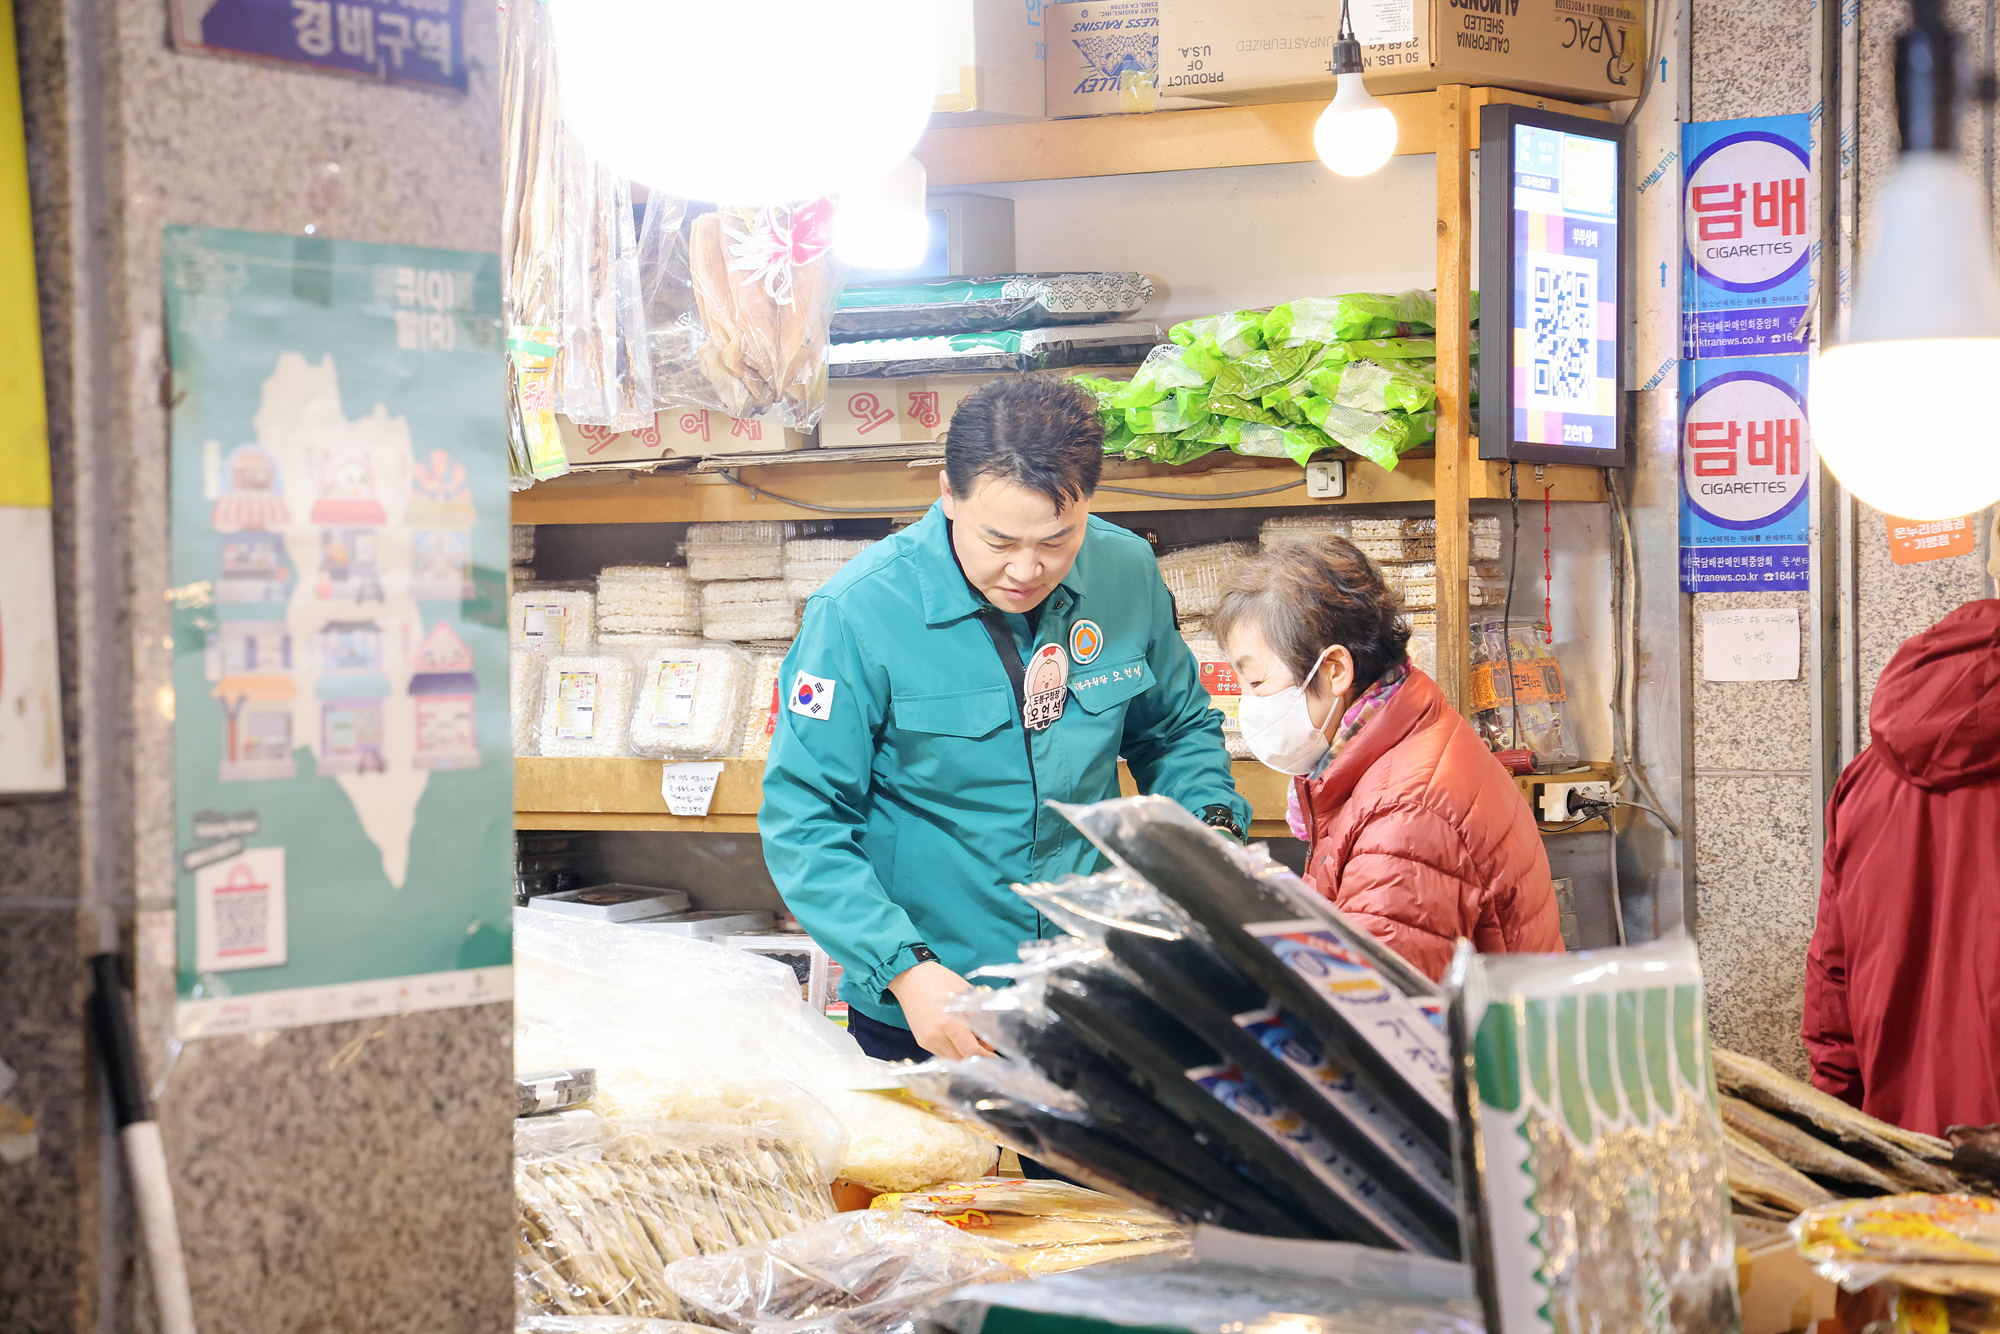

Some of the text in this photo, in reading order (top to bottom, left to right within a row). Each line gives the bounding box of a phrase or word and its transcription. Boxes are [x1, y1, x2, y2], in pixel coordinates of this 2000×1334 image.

[1071, 19, 1124, 33] RAISINS
[1463, 14, 1505, 35] SHELLED
[292, 1, 454, 77] 경비구역
[1236, 35, 1335, 52] UNPASTEURIZED
[1457, 31, 1510, 54] CALIFORNIA
[1177, 45, 1211, 58] U.S.A.
[1375, 53, 1401, 66] LBS.
[1405, 51, 1419, 63] 50
[1187, 60, 1204, 71] OF
[1167, 72, 1224, 87] PRODUCT
[1658, 151, 1679, 171] STEEL
[1693, 178, 1806, 241] 담배
[1706, 241, 1792, 259] CIGARETTES
[1702, 299, 1744, 309] 청소년에게는
[1771, 294, 1800, 304] 판매하지
[1658, 357, 1678, 377] STEEL
[1688, 419, 1800, 477] 담배
[1701, 481, 1787, 495] CIGARETTES
[1894, 517, 1966, 539] 온누리상품권
[1696, 535, 1737, 544] 청소년에게는
[1765, 533, 1794, 542] 판매하지
[1913, 533, 1950, 550] 가맹점
[1217, 669, 1233, 682] 구운
[1513, 672, 1531, 691] 호박
[1033, 690, 1061, 705] 도봉구청장
